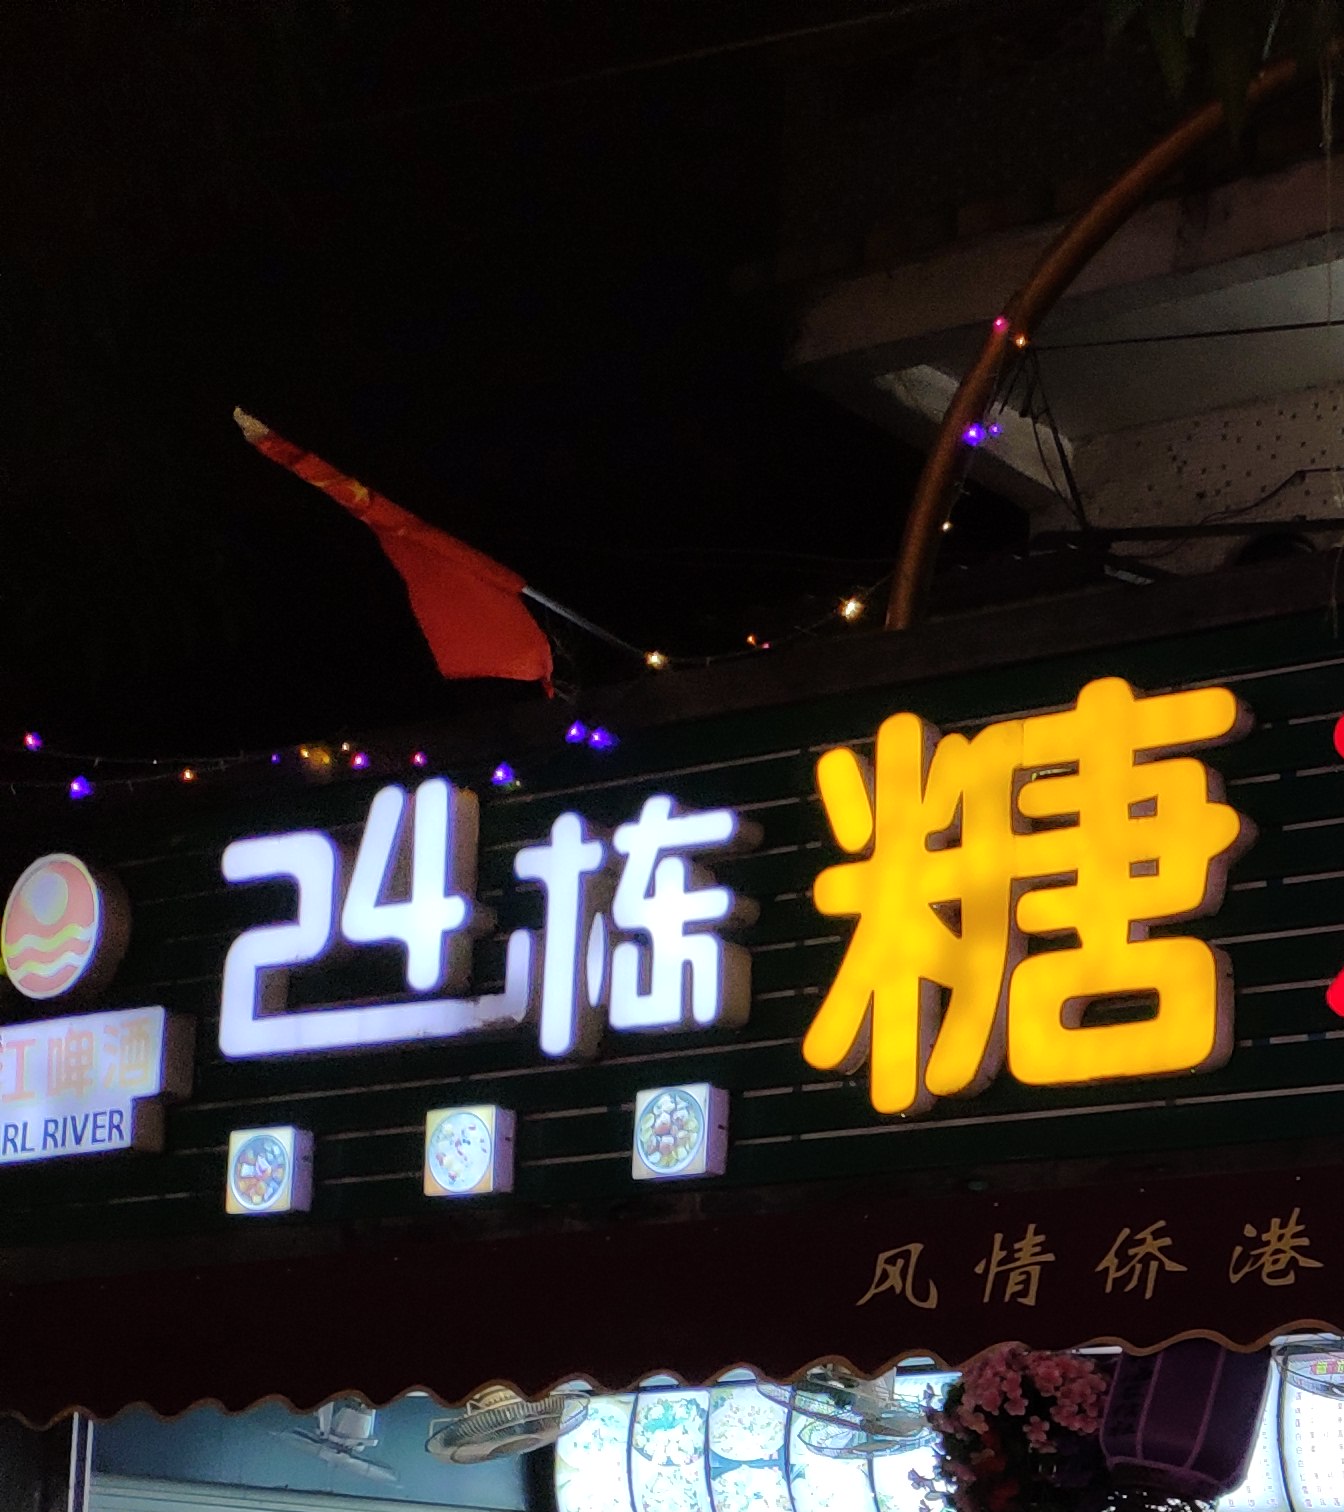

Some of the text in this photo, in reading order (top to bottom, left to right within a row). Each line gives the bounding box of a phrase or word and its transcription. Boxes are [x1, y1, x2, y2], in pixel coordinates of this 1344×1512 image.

[41, 1108, 126, 1151] RIVER
[856, 1207, 1325, 1310] 风情侨港
